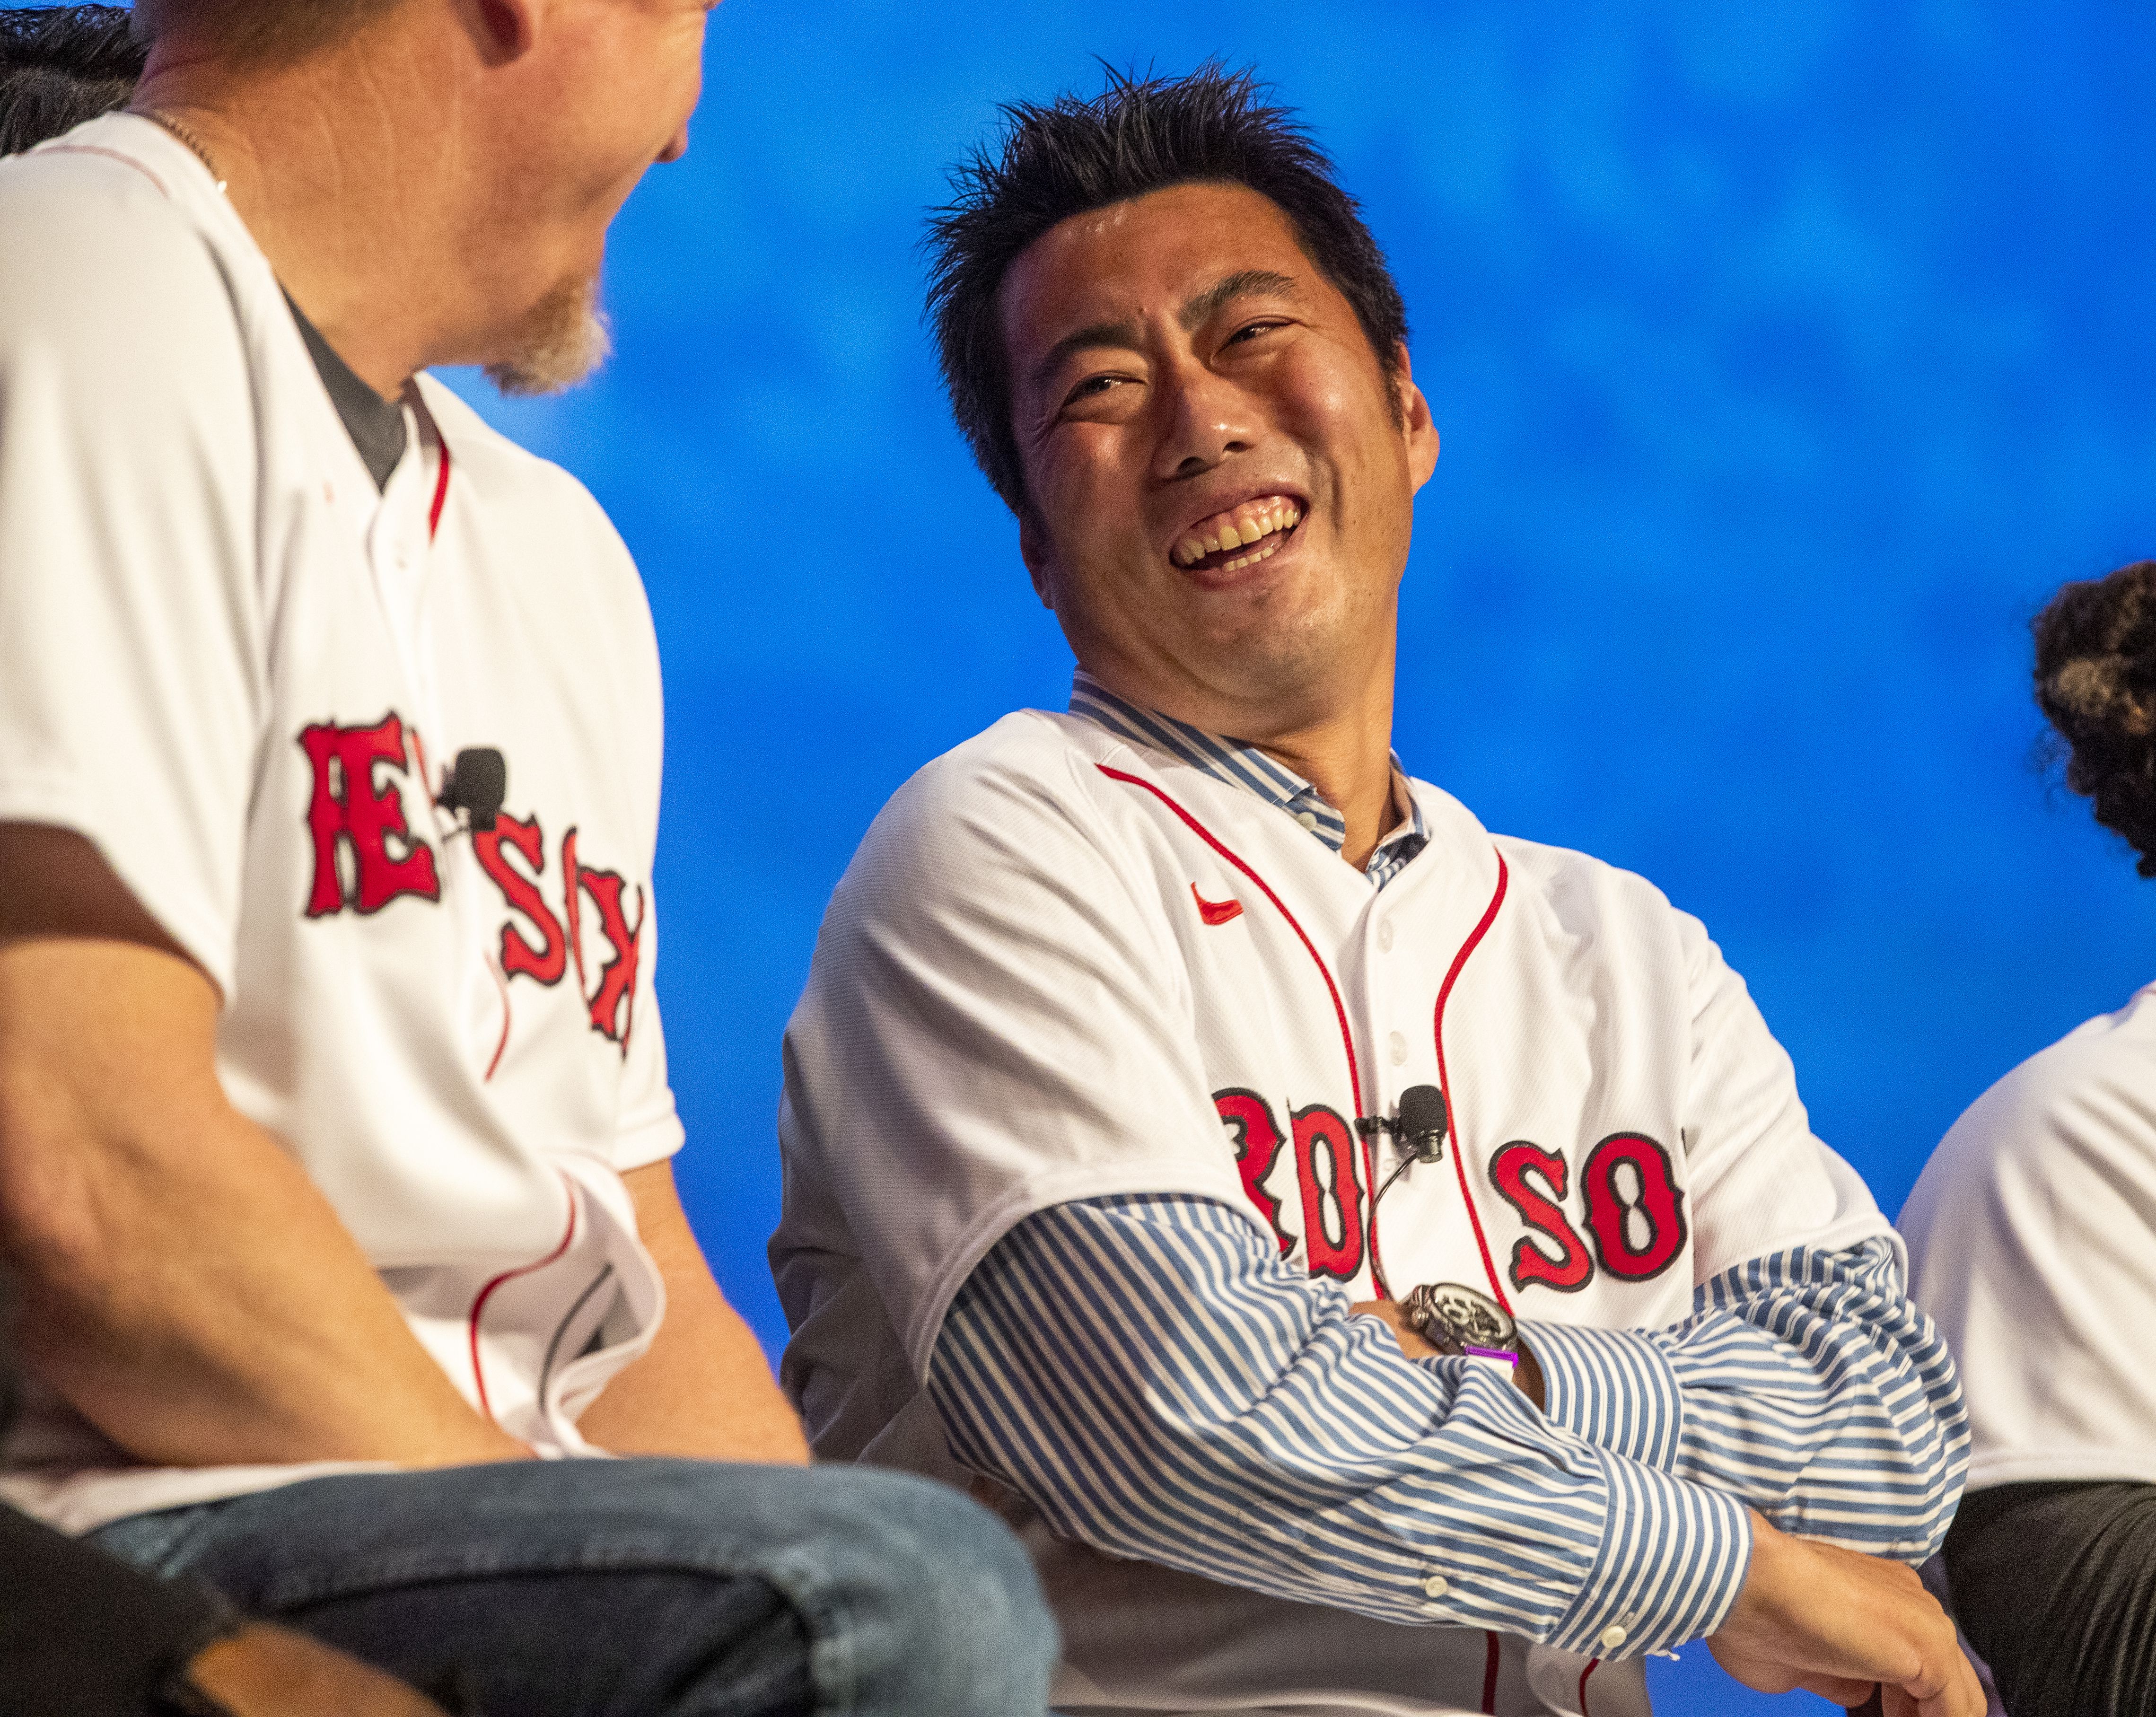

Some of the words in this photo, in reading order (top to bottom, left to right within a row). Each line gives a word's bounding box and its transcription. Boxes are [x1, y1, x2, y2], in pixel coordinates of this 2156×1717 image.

[472, 809, 645, 1060] SX
[1211, 1087, 1366, 1283] RD
[1488, 1127, 1688, 1293] SO
